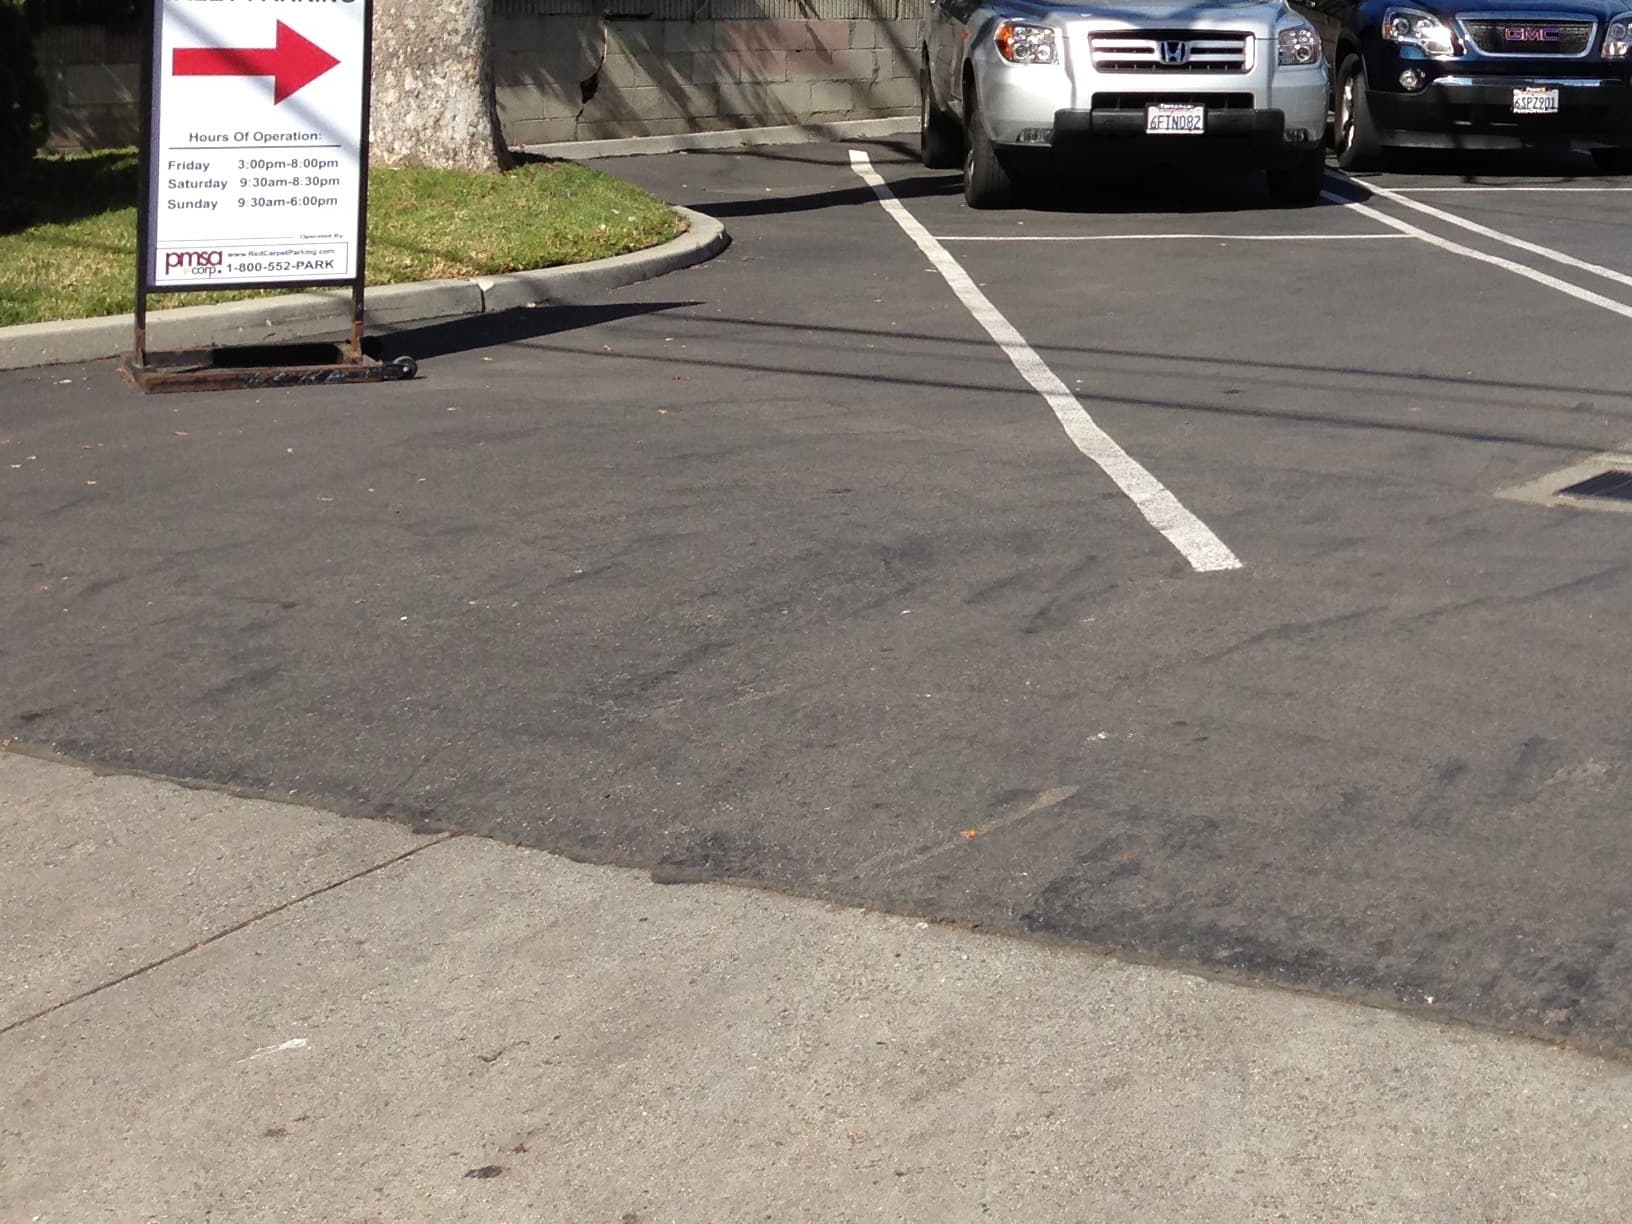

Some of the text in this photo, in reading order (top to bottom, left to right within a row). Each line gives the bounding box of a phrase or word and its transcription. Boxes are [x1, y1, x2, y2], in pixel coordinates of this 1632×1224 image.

[1505, 27, 1560, 41] GMC
[189, 131, 229, 142] Hours
[233, 131, 250, 142] Of
[168, 160, 210, 172] Friday
[168, 178, 228, 191] Saturday
[167, 199, 218, 211] Sunday
[226, 259, 335, 273] 1-800-552-PARK
